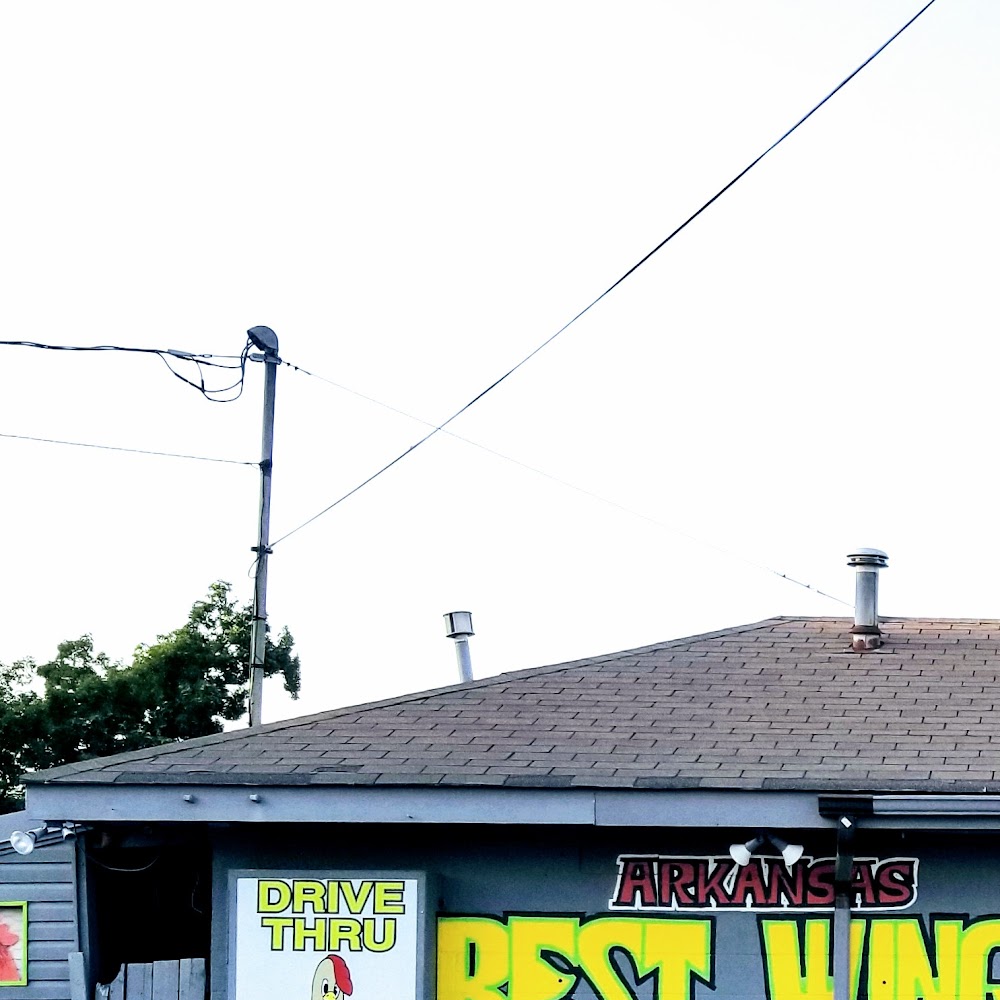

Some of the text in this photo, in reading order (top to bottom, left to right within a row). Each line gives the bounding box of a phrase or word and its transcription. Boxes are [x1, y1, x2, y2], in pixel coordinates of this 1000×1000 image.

[257, 879, 405, 914] DRIVE
[609, 855, 918, 910] ARKANSAS
[261, 917, 397, 952] THRU
